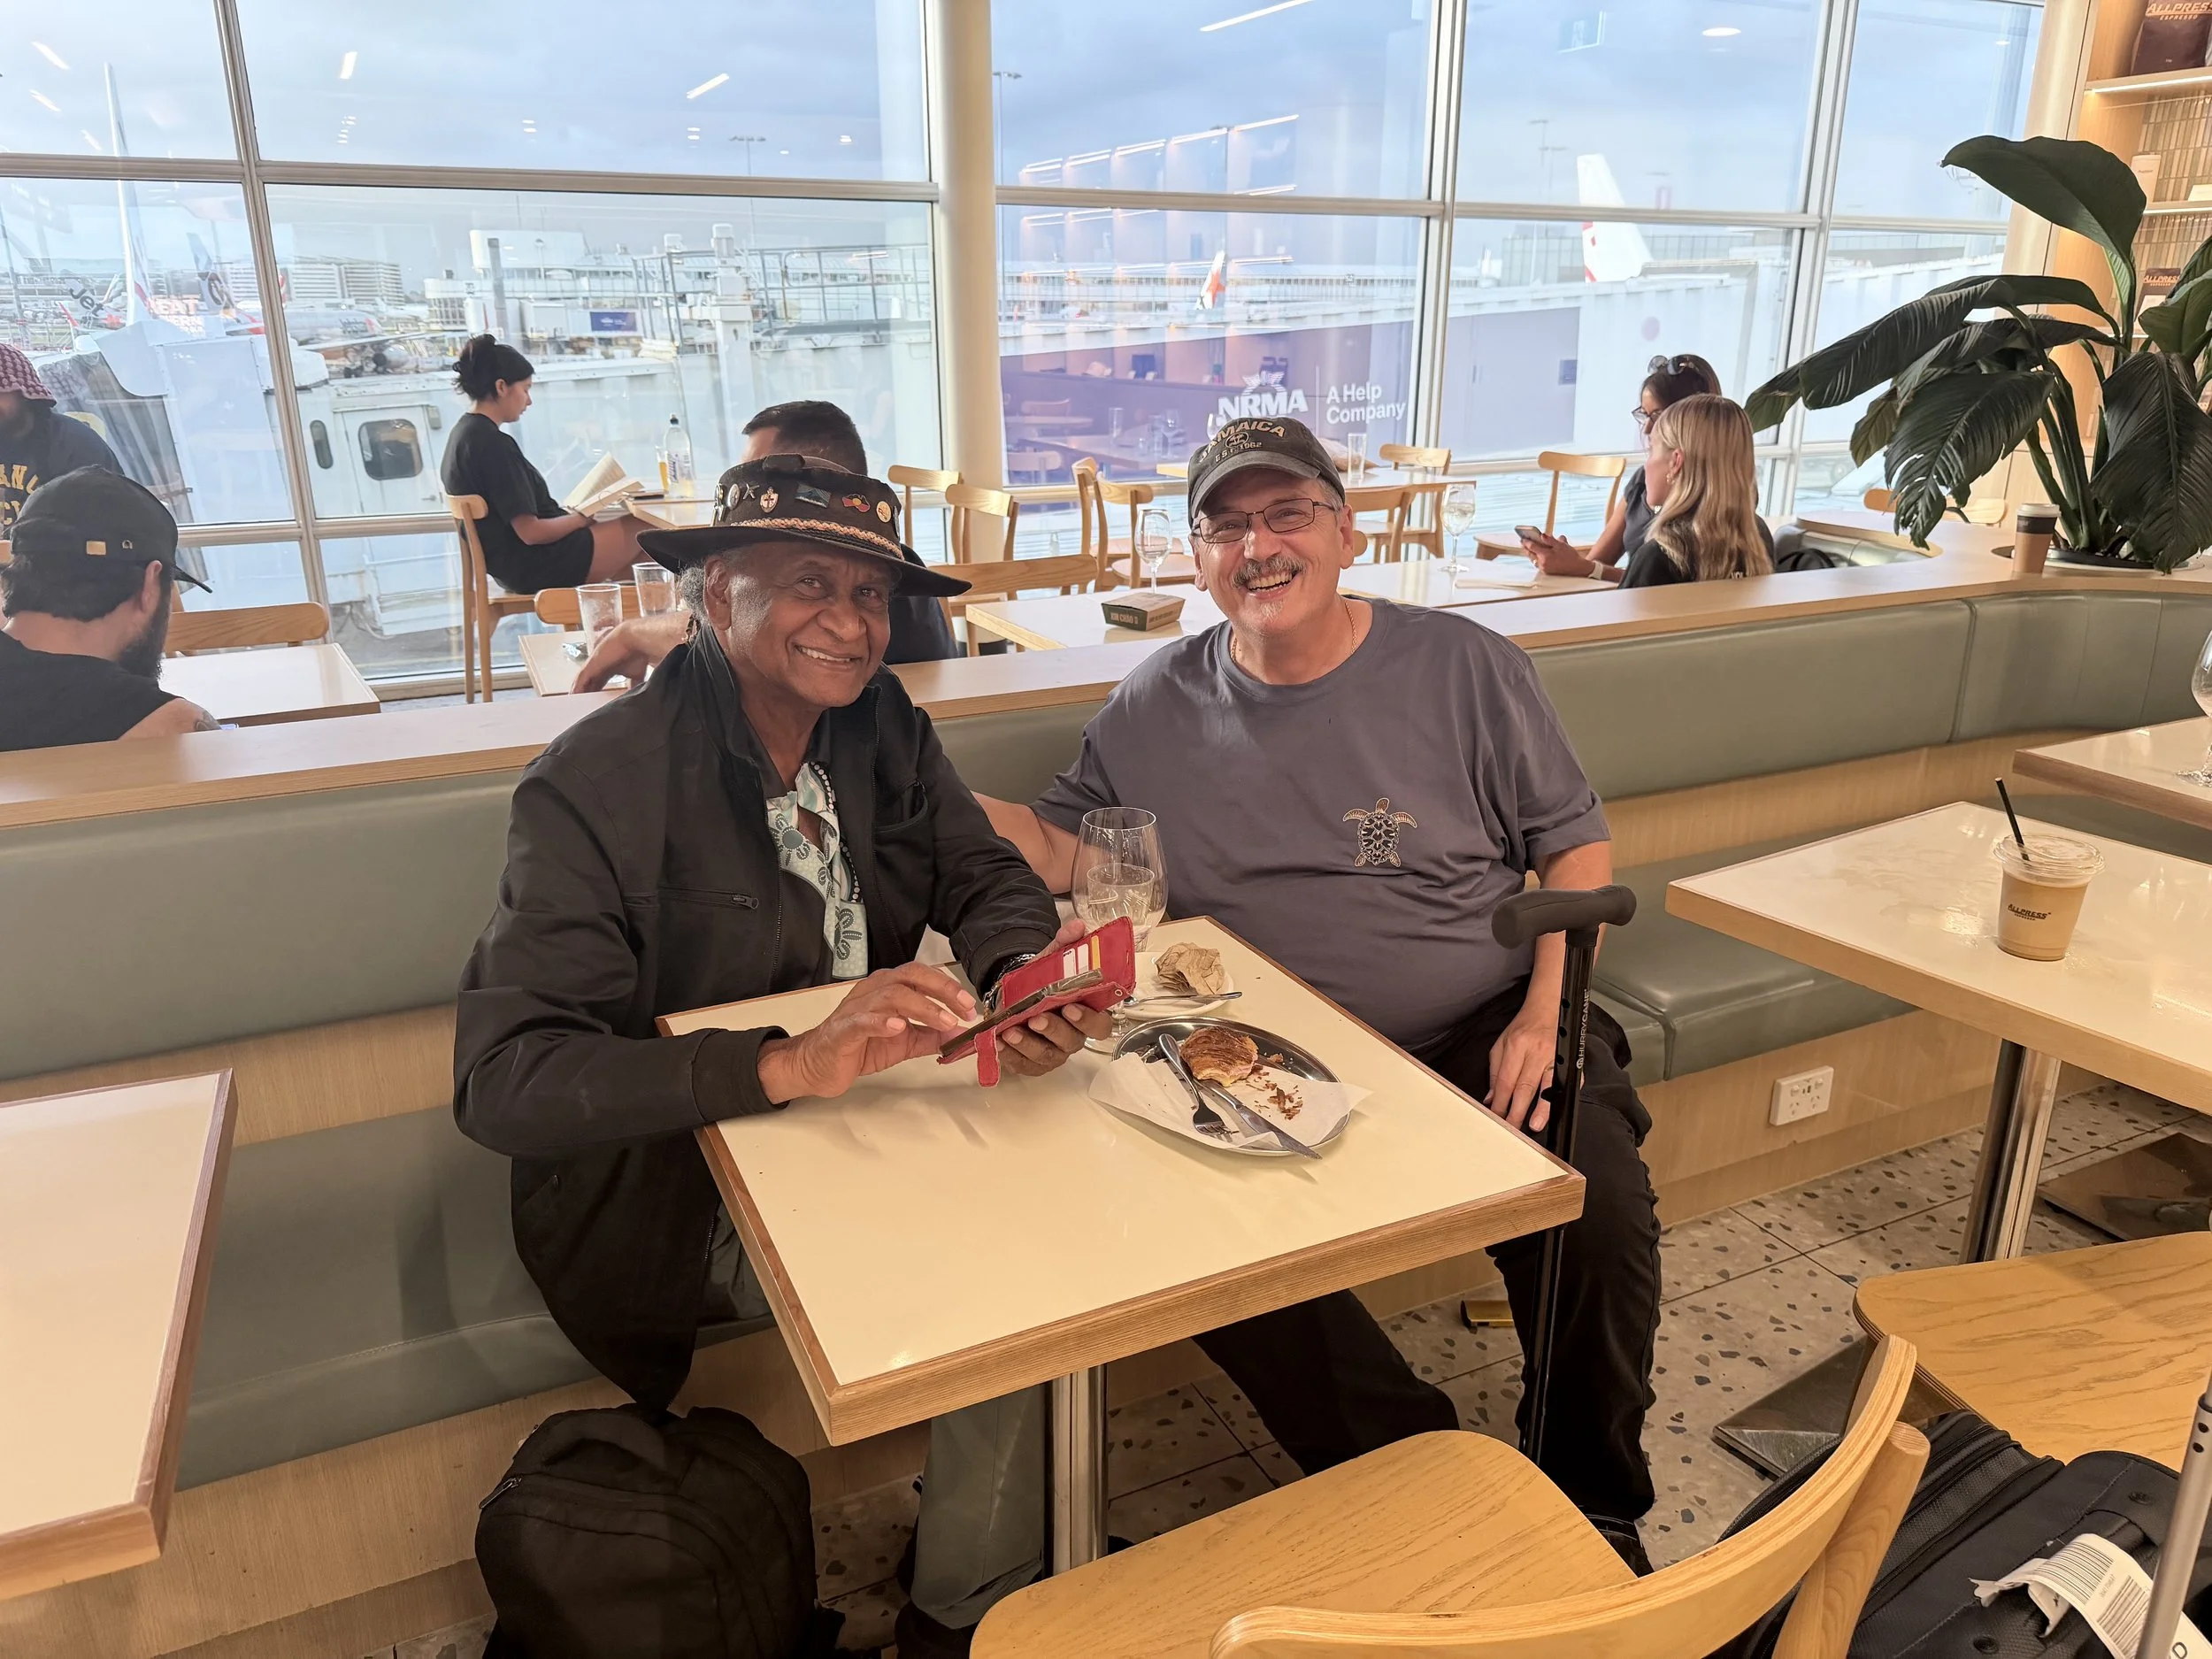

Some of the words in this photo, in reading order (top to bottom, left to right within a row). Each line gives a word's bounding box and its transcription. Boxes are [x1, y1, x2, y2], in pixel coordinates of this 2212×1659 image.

[1216, 388, 1309, 426] NRMA
[1326, 389, 1340, 404] A
[1342, 381, 1381, 403] Help
[1326, 401, 1406, 425] Company
[1199, 421, 1286, 463] JAMAICA
[2008, 903, 2048, 920] ALLPRESS
[1578, 990, 1589, 1057] HURRYCANE
